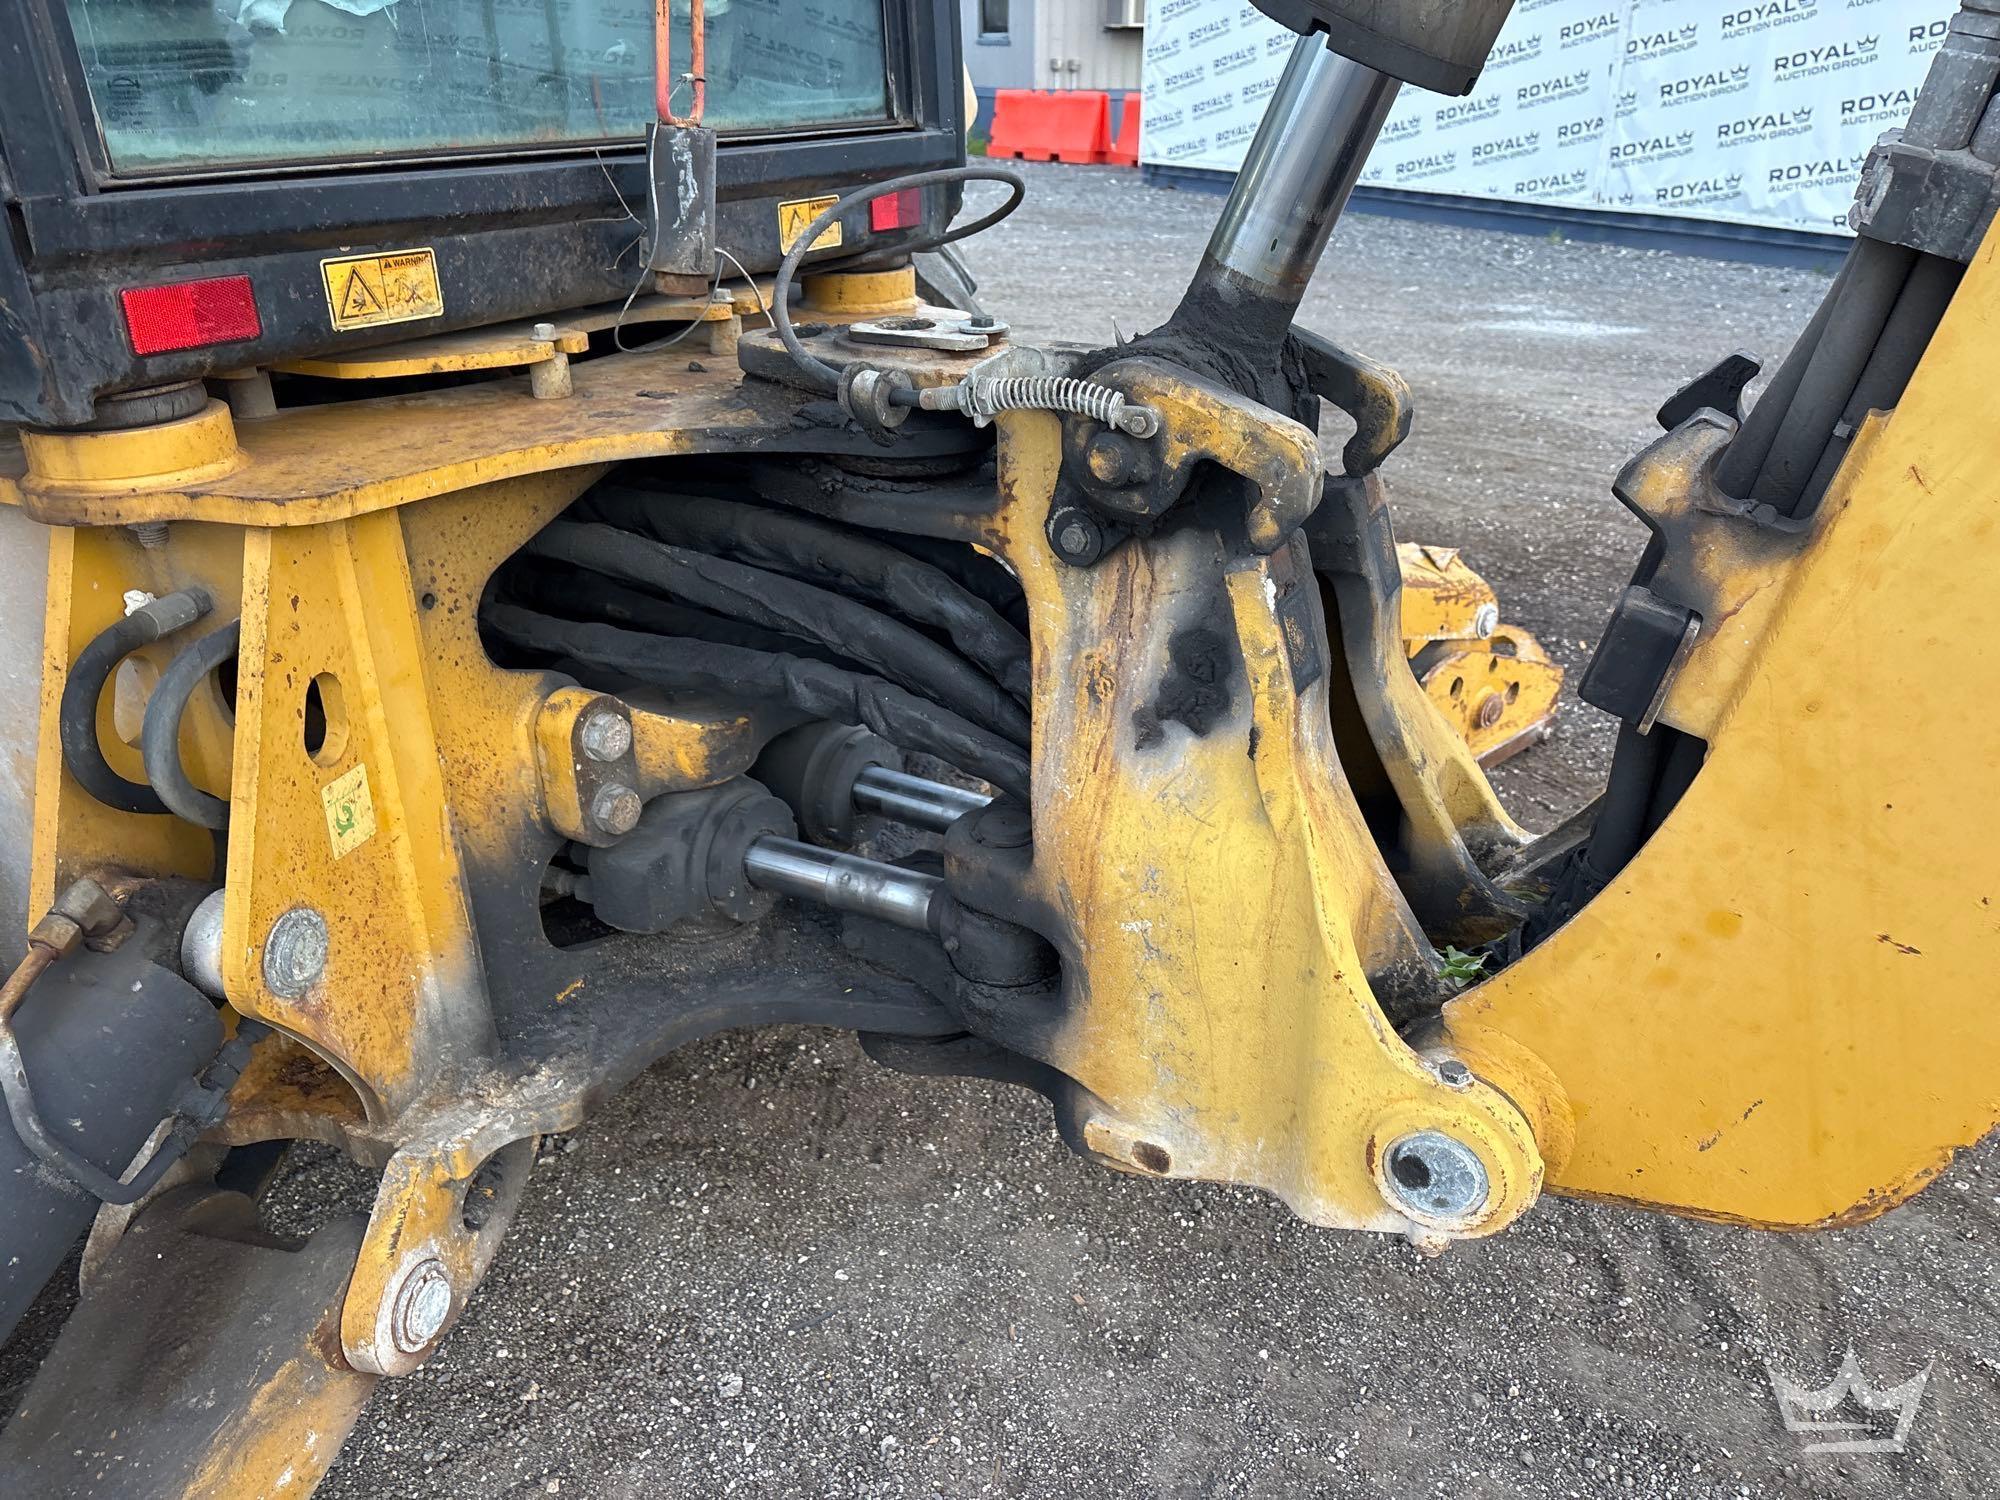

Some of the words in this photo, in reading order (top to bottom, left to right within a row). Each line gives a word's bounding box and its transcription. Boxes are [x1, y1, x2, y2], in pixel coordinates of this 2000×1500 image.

[1560, 12, 1619, 40] ROYAL
[1721, 0, 1796, 29] ROYAL
[1721, 20, 1771, 41] AUCTION
[1772, 9, 1818, 28] GROUP
[1626, 31, 1678, 54] OYAL
[1774, 42, 1856, 72] ROYAL
[1774, 64, 1831, 83] AUCTION
[1832, 54, 1879, 71] GROUP
[1517, 76, 1573, 100] ROYAL
[1660, 71, 1730, 98] ROYAL
[1660, 91, 1708, 107] AUCTION
[1709, 82, 1749, 98] GROUP
[1436, 99, 1486, 122] ROYAL
[1841, 109, 1900, 126] AUCTION
[1717, 112, 1792, 139] ROYAL
[1717, 132, 1768, 149] AUCTION
[1769, 123, 1813, 141] GROUP
[1472, 136, 1525, 158] ROYAL
[1610, 136, 1675, 159] ROYAL
[1396, 154, 1443, 174] ROYAL
[1769, 159, 1848, 183] ROYAL
[1515, 173, 1570, 194] ROYAL
[1656, 179, 1724, 201] ROYAL
[1769, 178, 1825, 194] AUCTION
[1825, 172, 1861, 186] GROU
